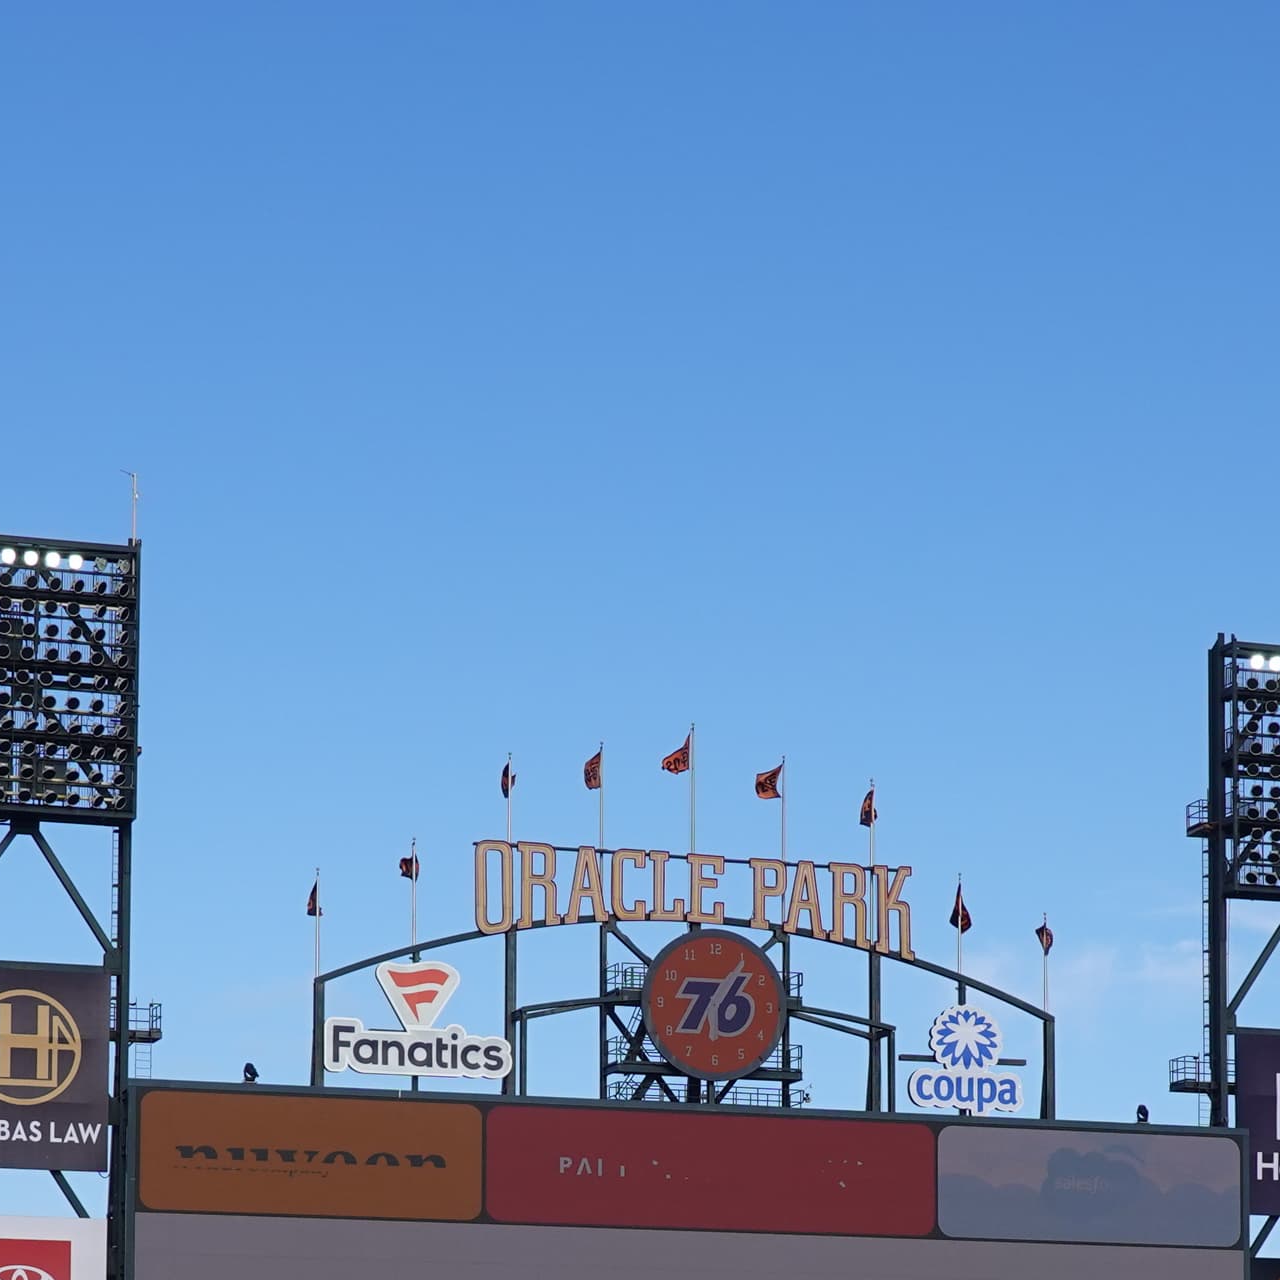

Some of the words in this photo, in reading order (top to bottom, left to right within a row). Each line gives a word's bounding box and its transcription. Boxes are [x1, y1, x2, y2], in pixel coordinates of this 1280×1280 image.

[474, 839, 725, 935] ORACLE
[749, 857, 915, 962] PARK
[685, 949, 696, 960] 11
[710, 943, 722, 955] 12
[665, 970, 677, 981] 10
[758, 975, 765, 986] 2
[657, 996, 664, 1008] 9
[675, 972, 755, 1037] 76
[766, 1003, 773, 1013] 3
[666, 1025, 673, 1036] 8
[758, 1030, 764, 1040] 4
[333, 1025, 504, 1071] Fanatics
[686, 1046, 692, 1056] 7
[738, 1048, 745, 1059] 5
[712, 1055, 719, 1066] 6
[916, 1074, 1017, 1112] coupa
[50, 1122, 102, 1144] LAW
